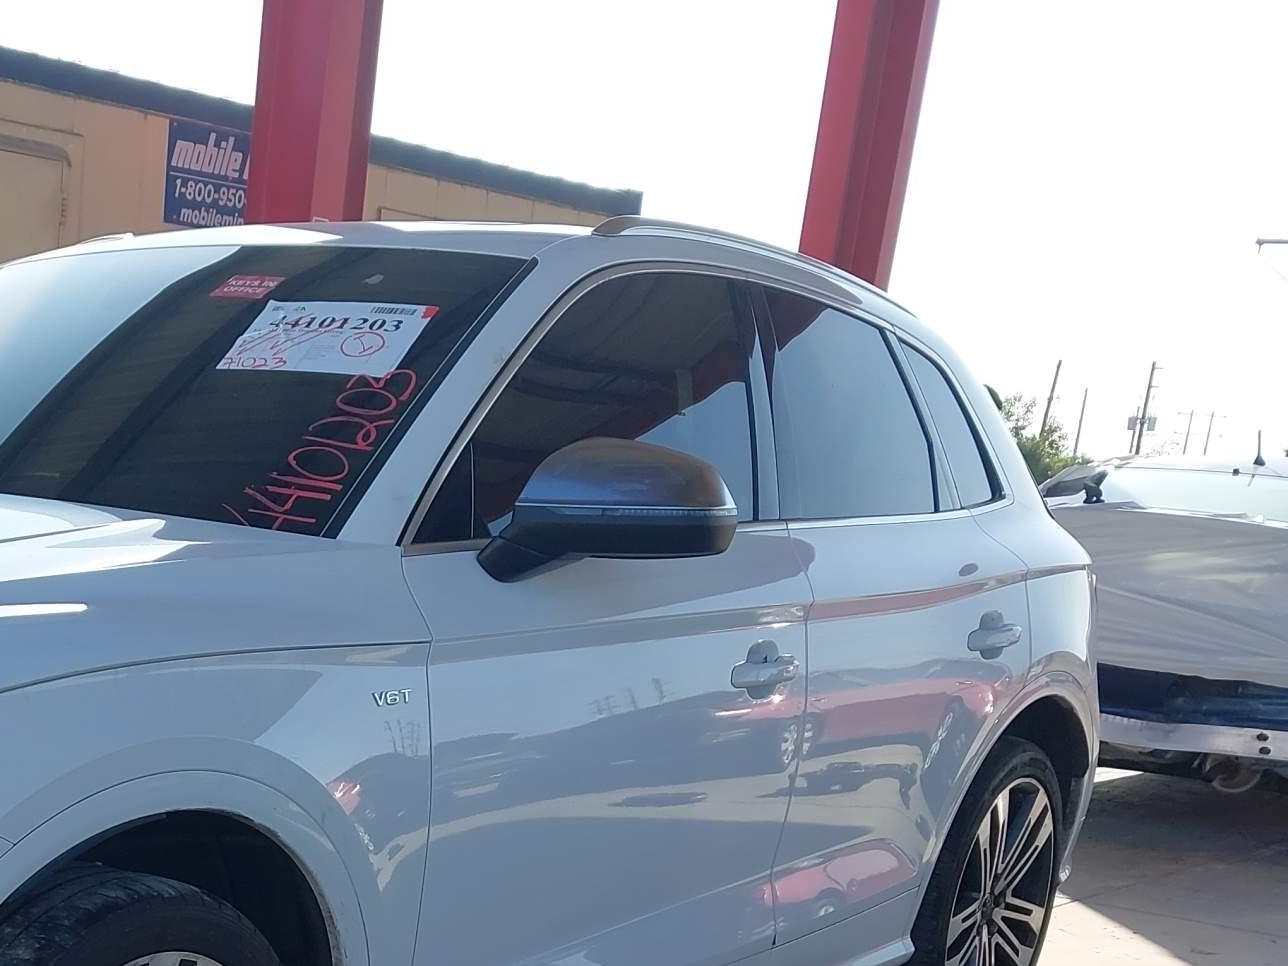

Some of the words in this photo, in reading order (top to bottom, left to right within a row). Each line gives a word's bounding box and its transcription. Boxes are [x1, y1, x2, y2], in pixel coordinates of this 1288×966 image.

[170, 132, 243, 178] mobile
[223, 286, 264, 294] OFFICE
[268, 314, 405, 333] 44101203
[372, 688, 412, 707] V6T
